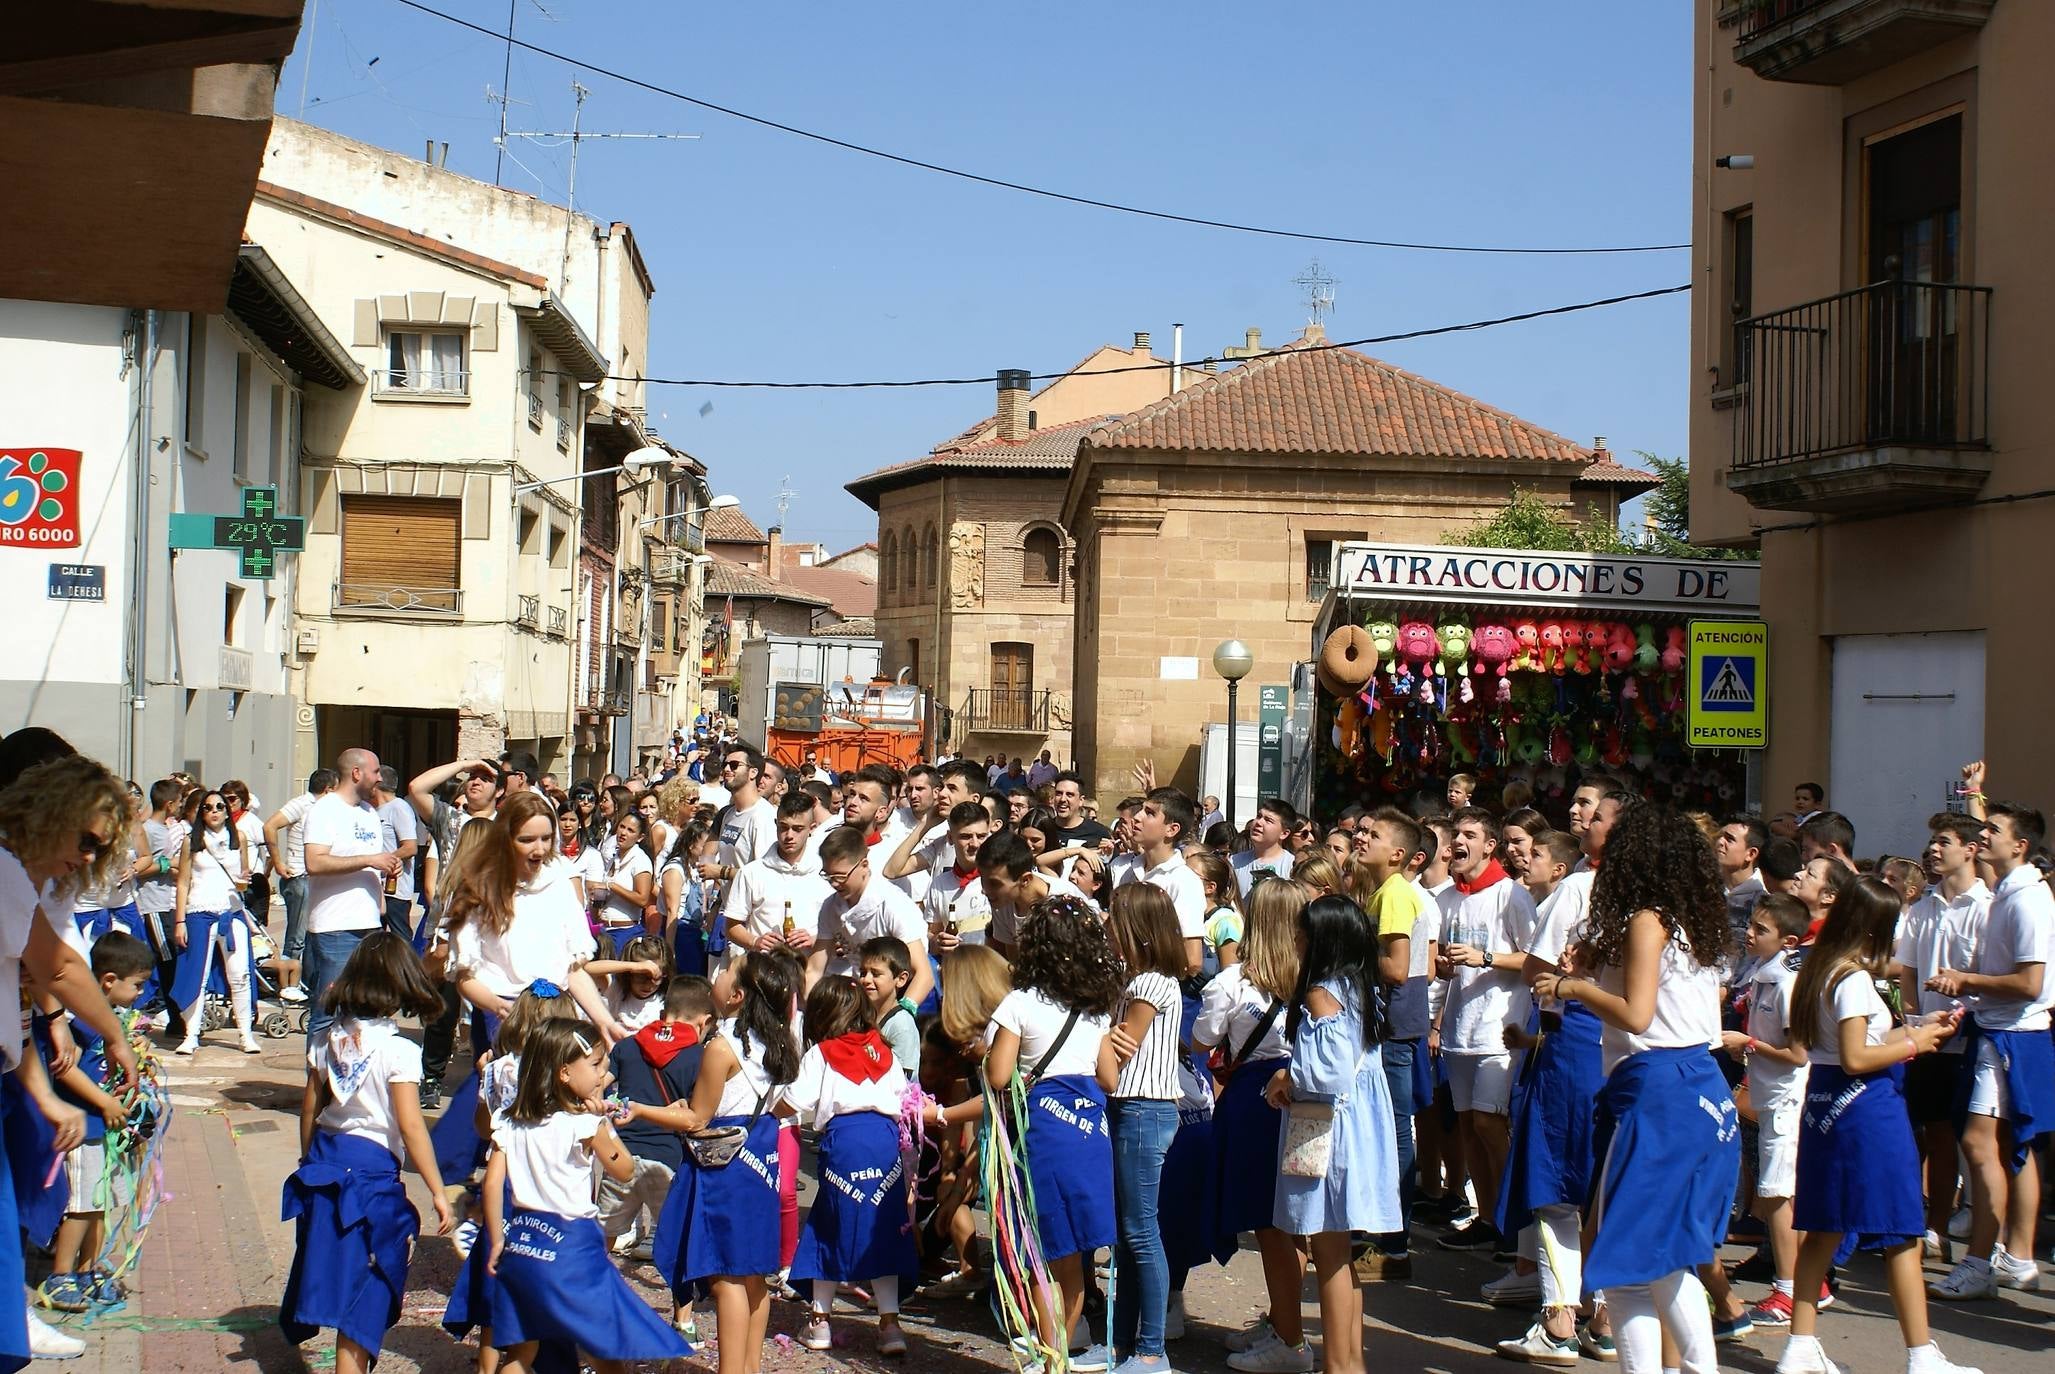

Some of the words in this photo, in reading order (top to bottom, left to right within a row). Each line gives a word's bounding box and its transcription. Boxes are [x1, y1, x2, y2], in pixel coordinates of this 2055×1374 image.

[0, 527, 25, 541] RO
[28, 528, 74, 542] 6000
[229, 522, 287, 545] 29°C
[61, 566, 94, 576] CALLE
[1355, 554, 1645, 596] ATRACCIONES
[1675, 568, 1729, 600] DE
[51, 585, 63, 596] LA
[1695, 631, 1763, 644] ATENCIÓN
[1693, 727, 1762, 739] PEATONES
[1246, 1001, 1266, 1021] VIRG
[1039, 1096, 1077, 1125] VIRGEN
[1078, 1117, 1094, 1135] DE
[1818, 1115, 1833, 1134] LOS
[1830, 1078, 1867, 1120] PARRALES
[738, 1146, 768, 1178] VIRGEN
[850, 1166, 884, 1182] PEÑA
[824, 1167, 853, 1195] VIRGEN
[851, 1187, 866, 1204] DE
[870, 1188, 886, 1206] LOS
[519, 1232, 532, 1242] DE
[524, 1216, 565, 1243] VIRGEN
[509, 1241, 557, 1262] PARRALES
